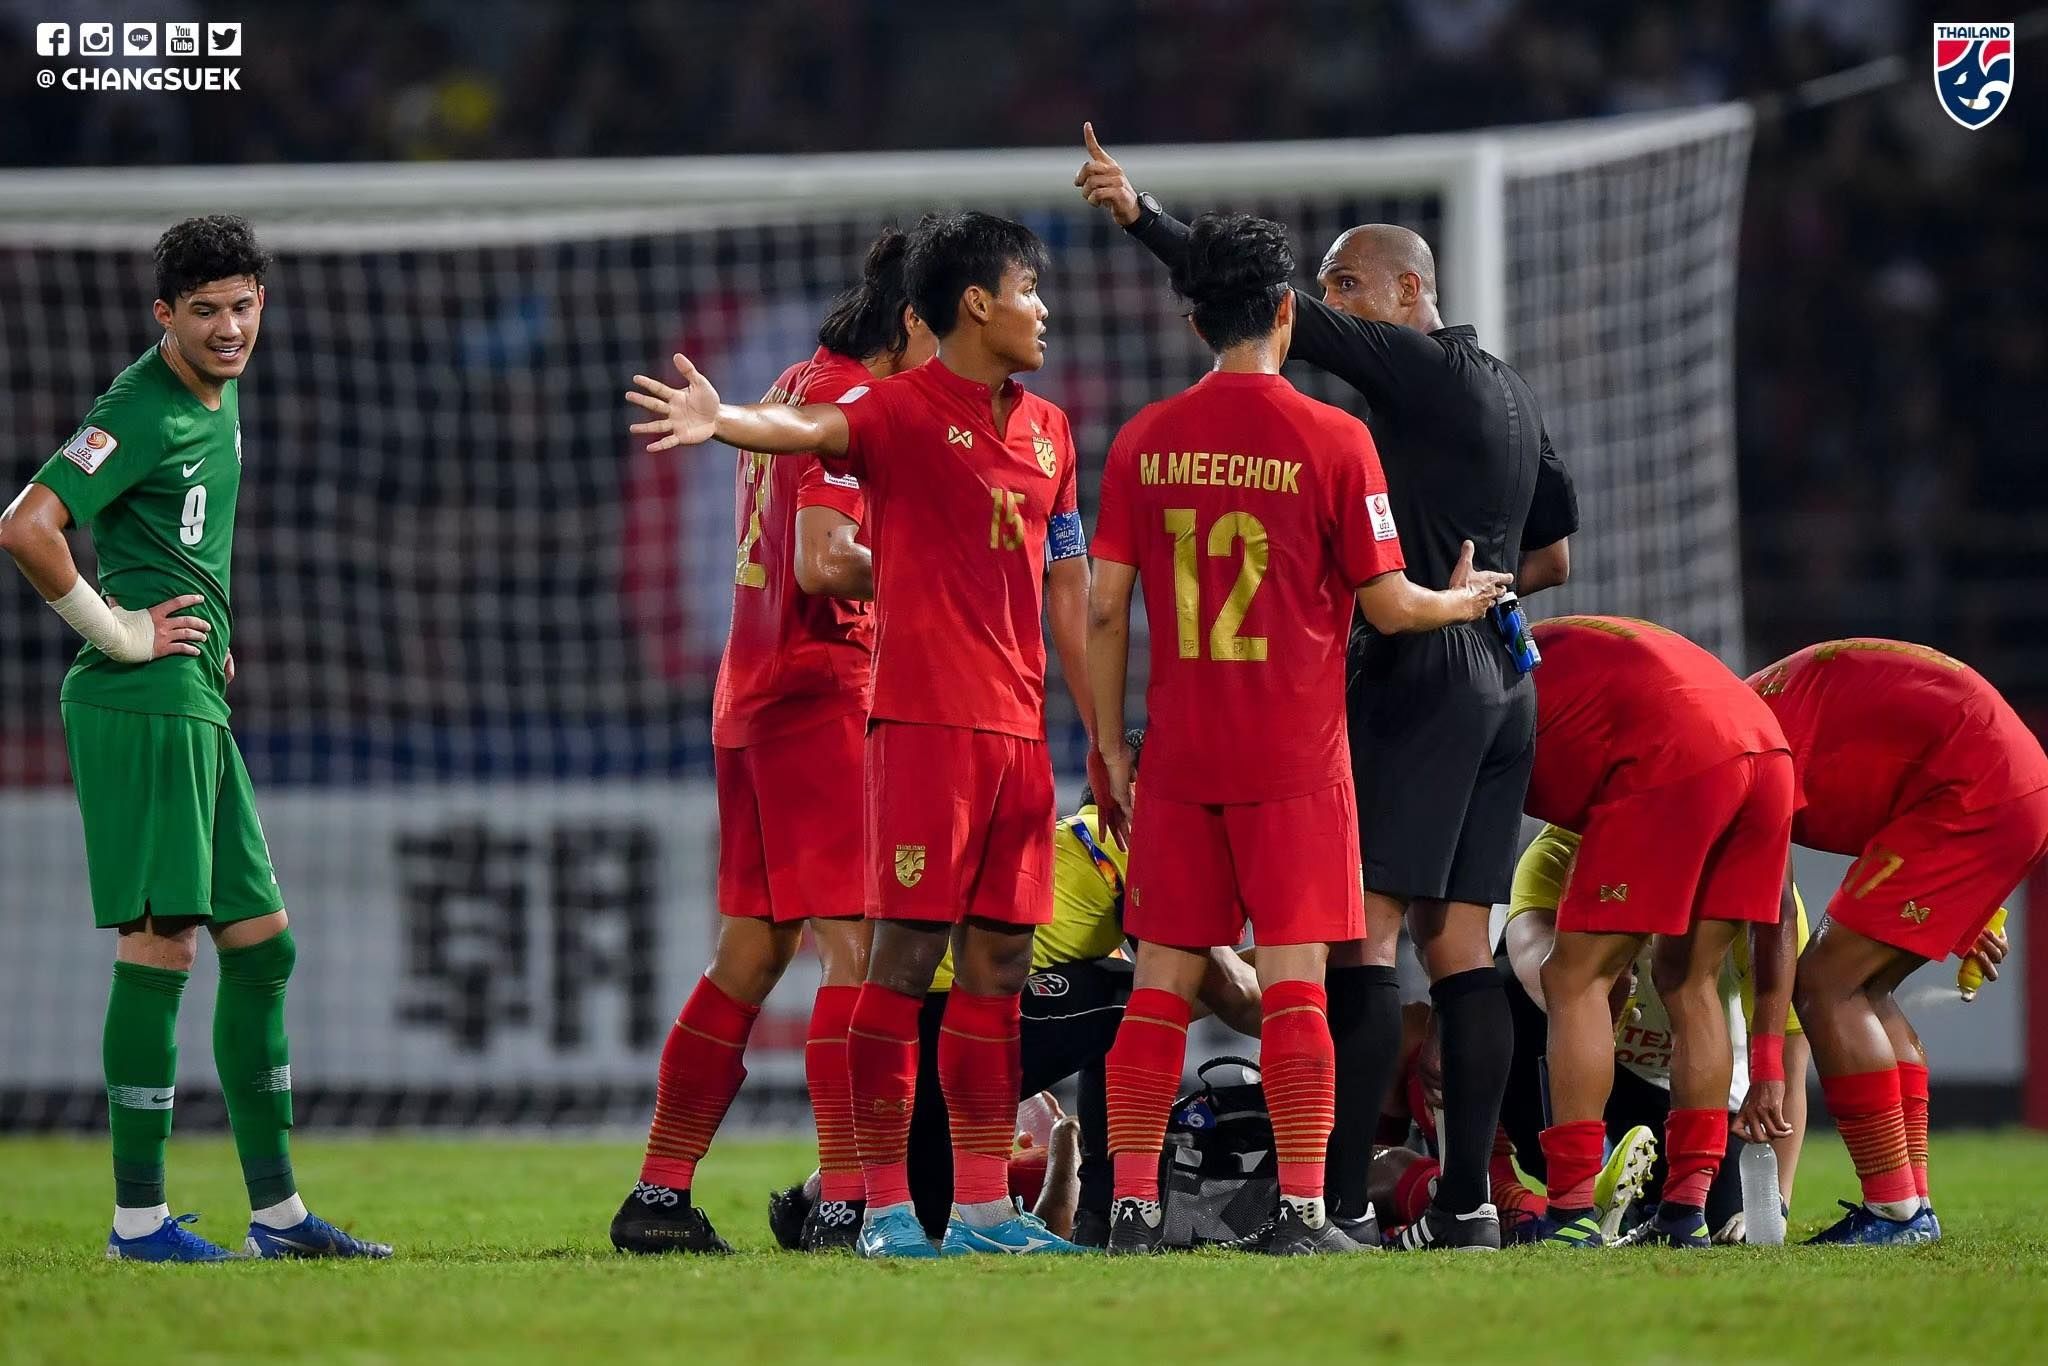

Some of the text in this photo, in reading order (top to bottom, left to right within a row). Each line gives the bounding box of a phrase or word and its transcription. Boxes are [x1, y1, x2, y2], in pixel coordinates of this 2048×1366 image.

[1140, 452, 1302, 494] M.MEECHOK
[180, 485, 207, 545] 9
[991, 487, 1025, 551] 15
[1163, 508, 1269, 661] 12
[1844, 846, 1904, 899] 17
[644, 1228, 691, 1238] NEMESIS
